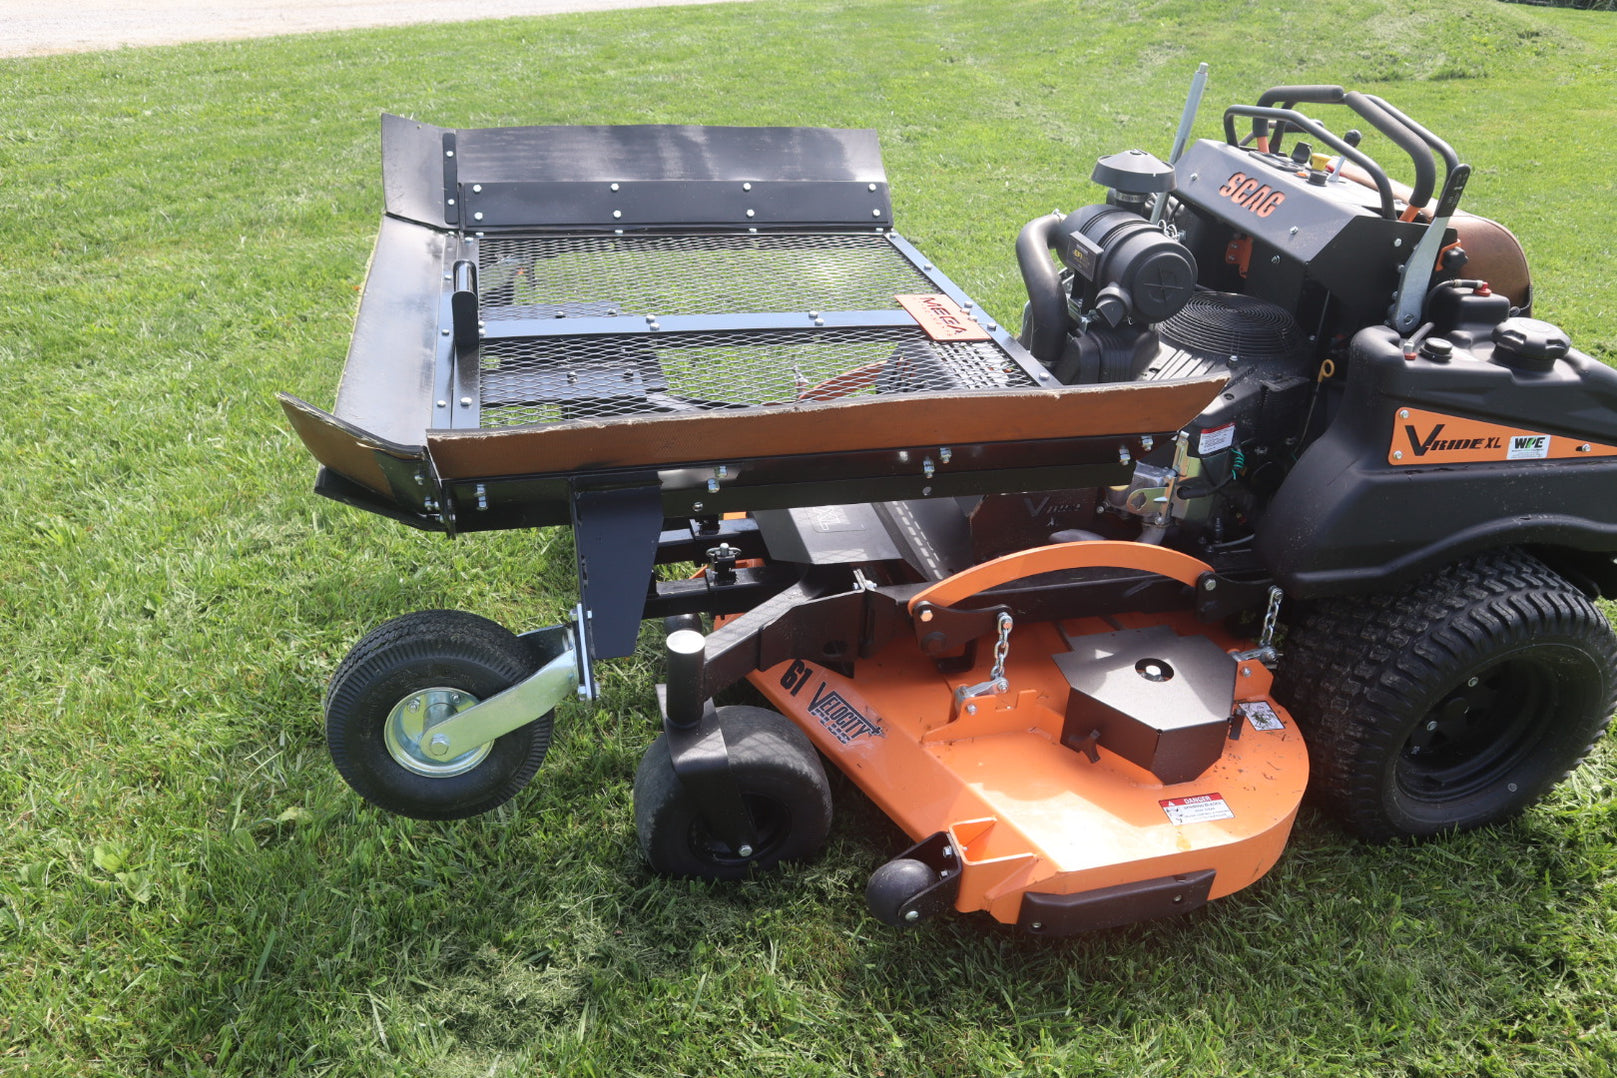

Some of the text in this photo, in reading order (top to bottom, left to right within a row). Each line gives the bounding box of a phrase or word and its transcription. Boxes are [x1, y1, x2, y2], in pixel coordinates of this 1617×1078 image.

[1219, 171, 1286, 218] SCAG
[920, 297, 967, 335] MEGA
[1485, 436, 1502, 449] XL
[1514, 436, 1546, 449] WPE
[780, 659, 814, 697] 61
[807, 681, 882, 739] VELOCITY
[1183, 795, 1212, 805] DANGER
